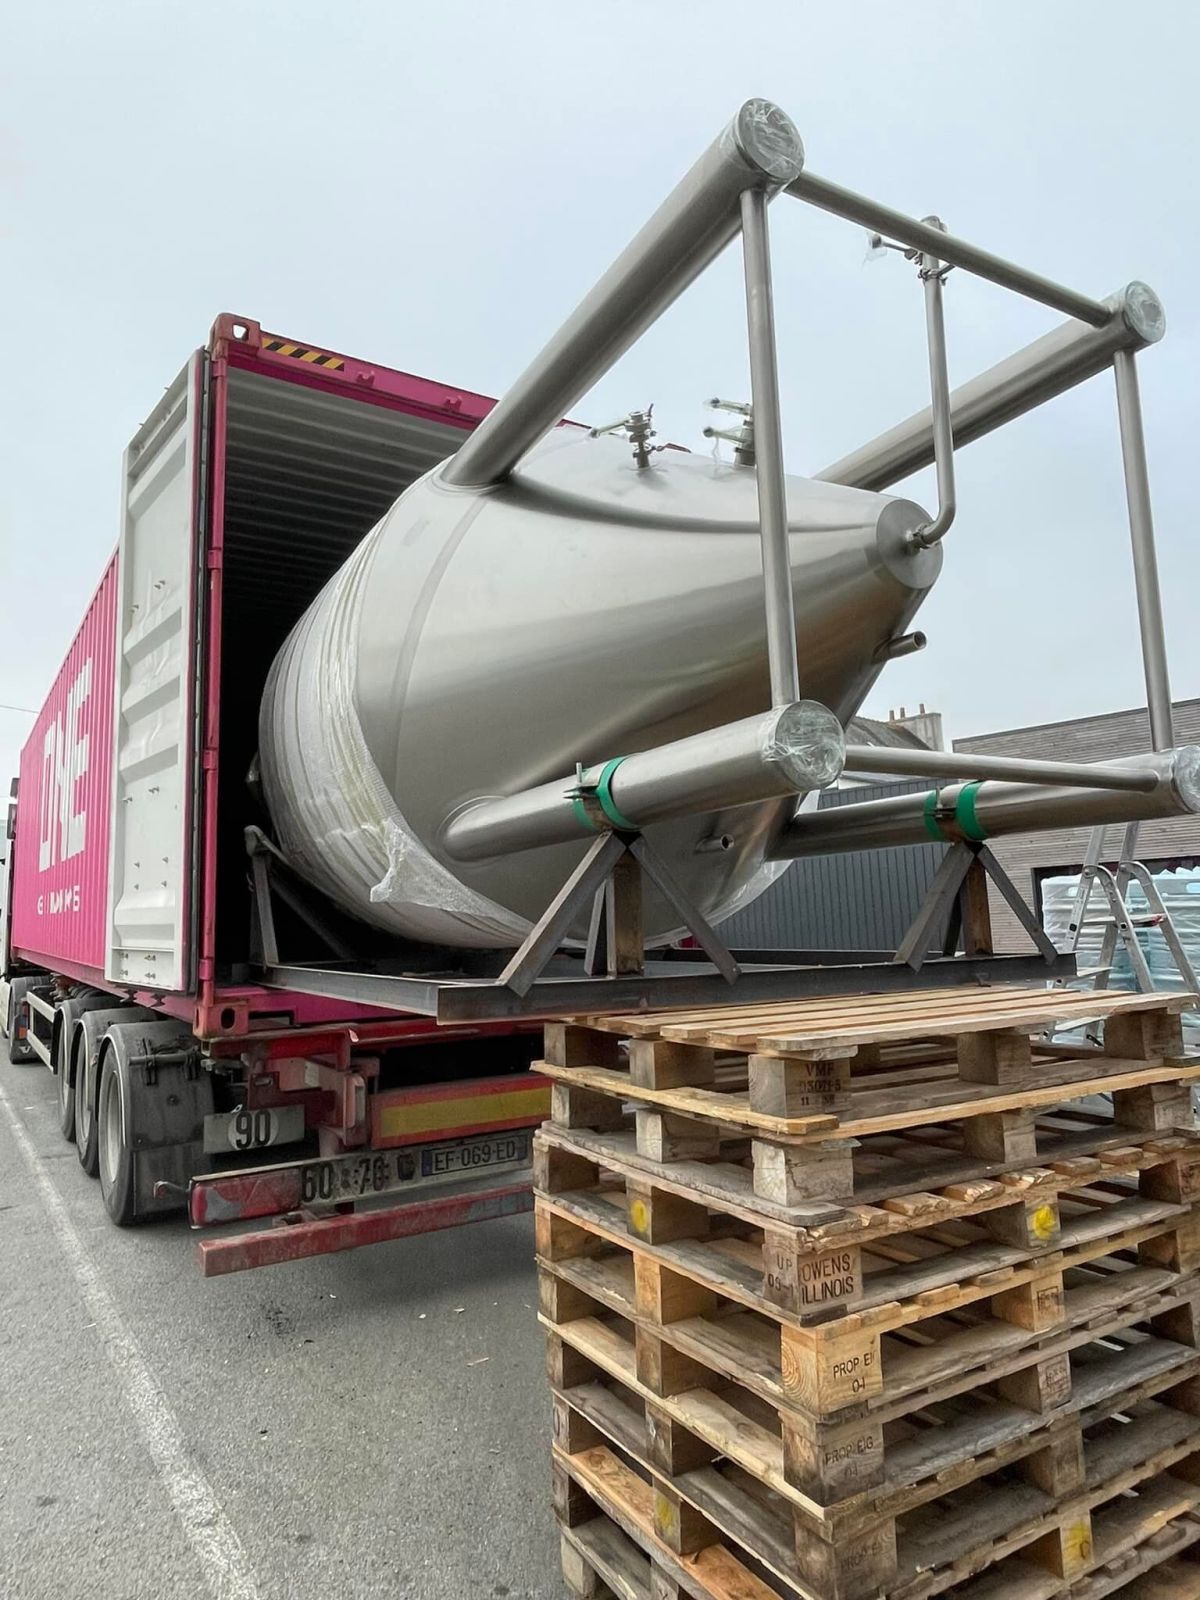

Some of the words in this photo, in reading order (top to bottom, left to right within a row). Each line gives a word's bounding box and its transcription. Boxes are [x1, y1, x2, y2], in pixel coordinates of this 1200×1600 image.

[236, 1109, 271, 1148] 90
[435, 1141, 516, 1171] EF-069-ED
[301, 1161, 334, 1202] 60
[802, 1253, 851, 1282] OWENS
[801, 1276, 854, 1305] ILLINOIS
[833, 1356, 860, 1380] PROP
